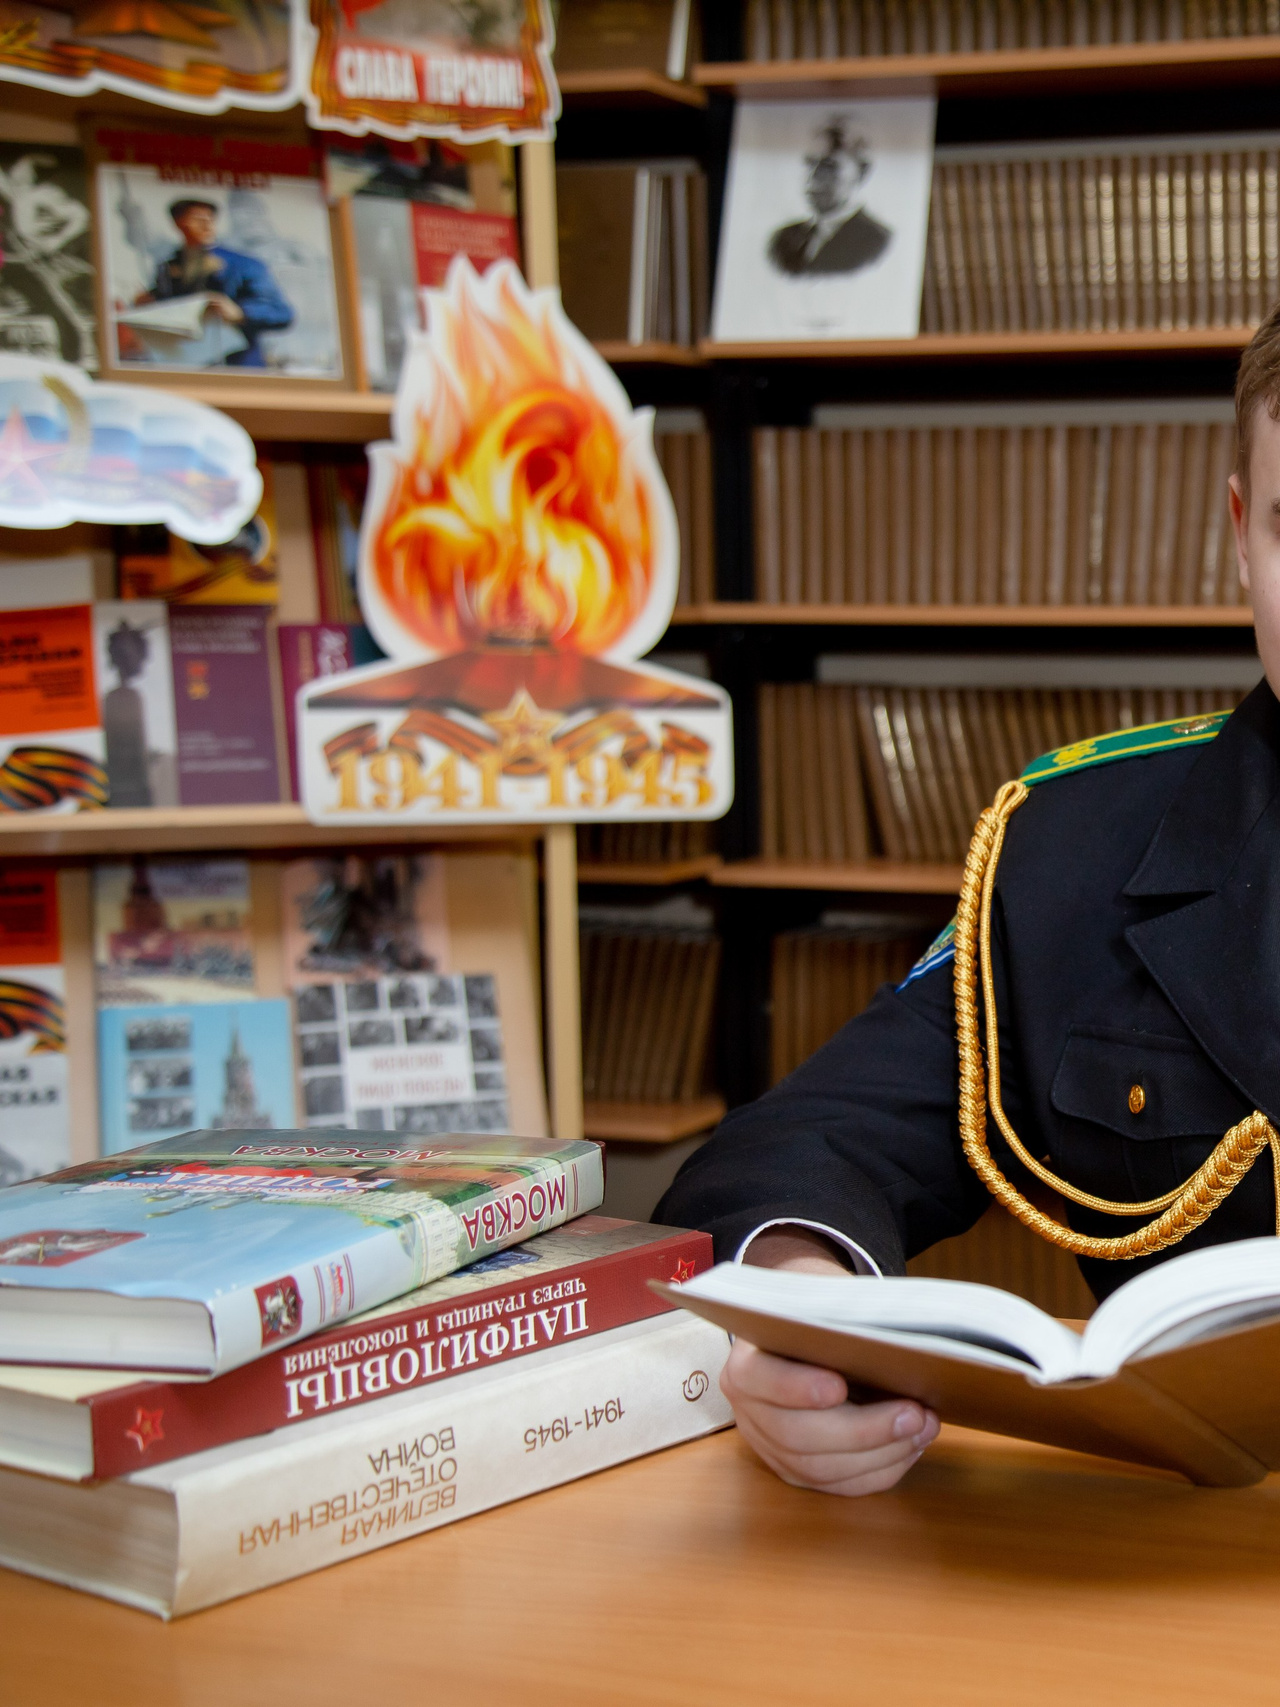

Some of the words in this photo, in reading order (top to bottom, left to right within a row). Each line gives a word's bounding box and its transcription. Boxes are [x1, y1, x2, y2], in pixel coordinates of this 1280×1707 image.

[338, 47, 419, 101] СЛАВА
[424, 56, 525, 110] ГЕРОЯМ!
[229, 1144, 452, 1161] МОСКВА
[460, 1172, 566, 1252] МОСКВА
[437, 1292, 527, 1332] ГРАНИЦЫ
[533, 1277, 588, 1305] ЧЕРЕЗ
[283, 1325, 408, 1375] ПОКОЛЕНИЯ
[415, 1318, 430, 1337] И
[285, 1298, 590, 1418] ПАНФИЛОВЦЫ
[367, 1426, 457, 1475] ВОЙНА
[523, 1397, 626, 1453] 1941-1945
[239, 1457, 458, 1555] ОТЕЧЕСТВЕННАЯ
[341, 1484, 457, 1546] ВЕЛИКАЯ
